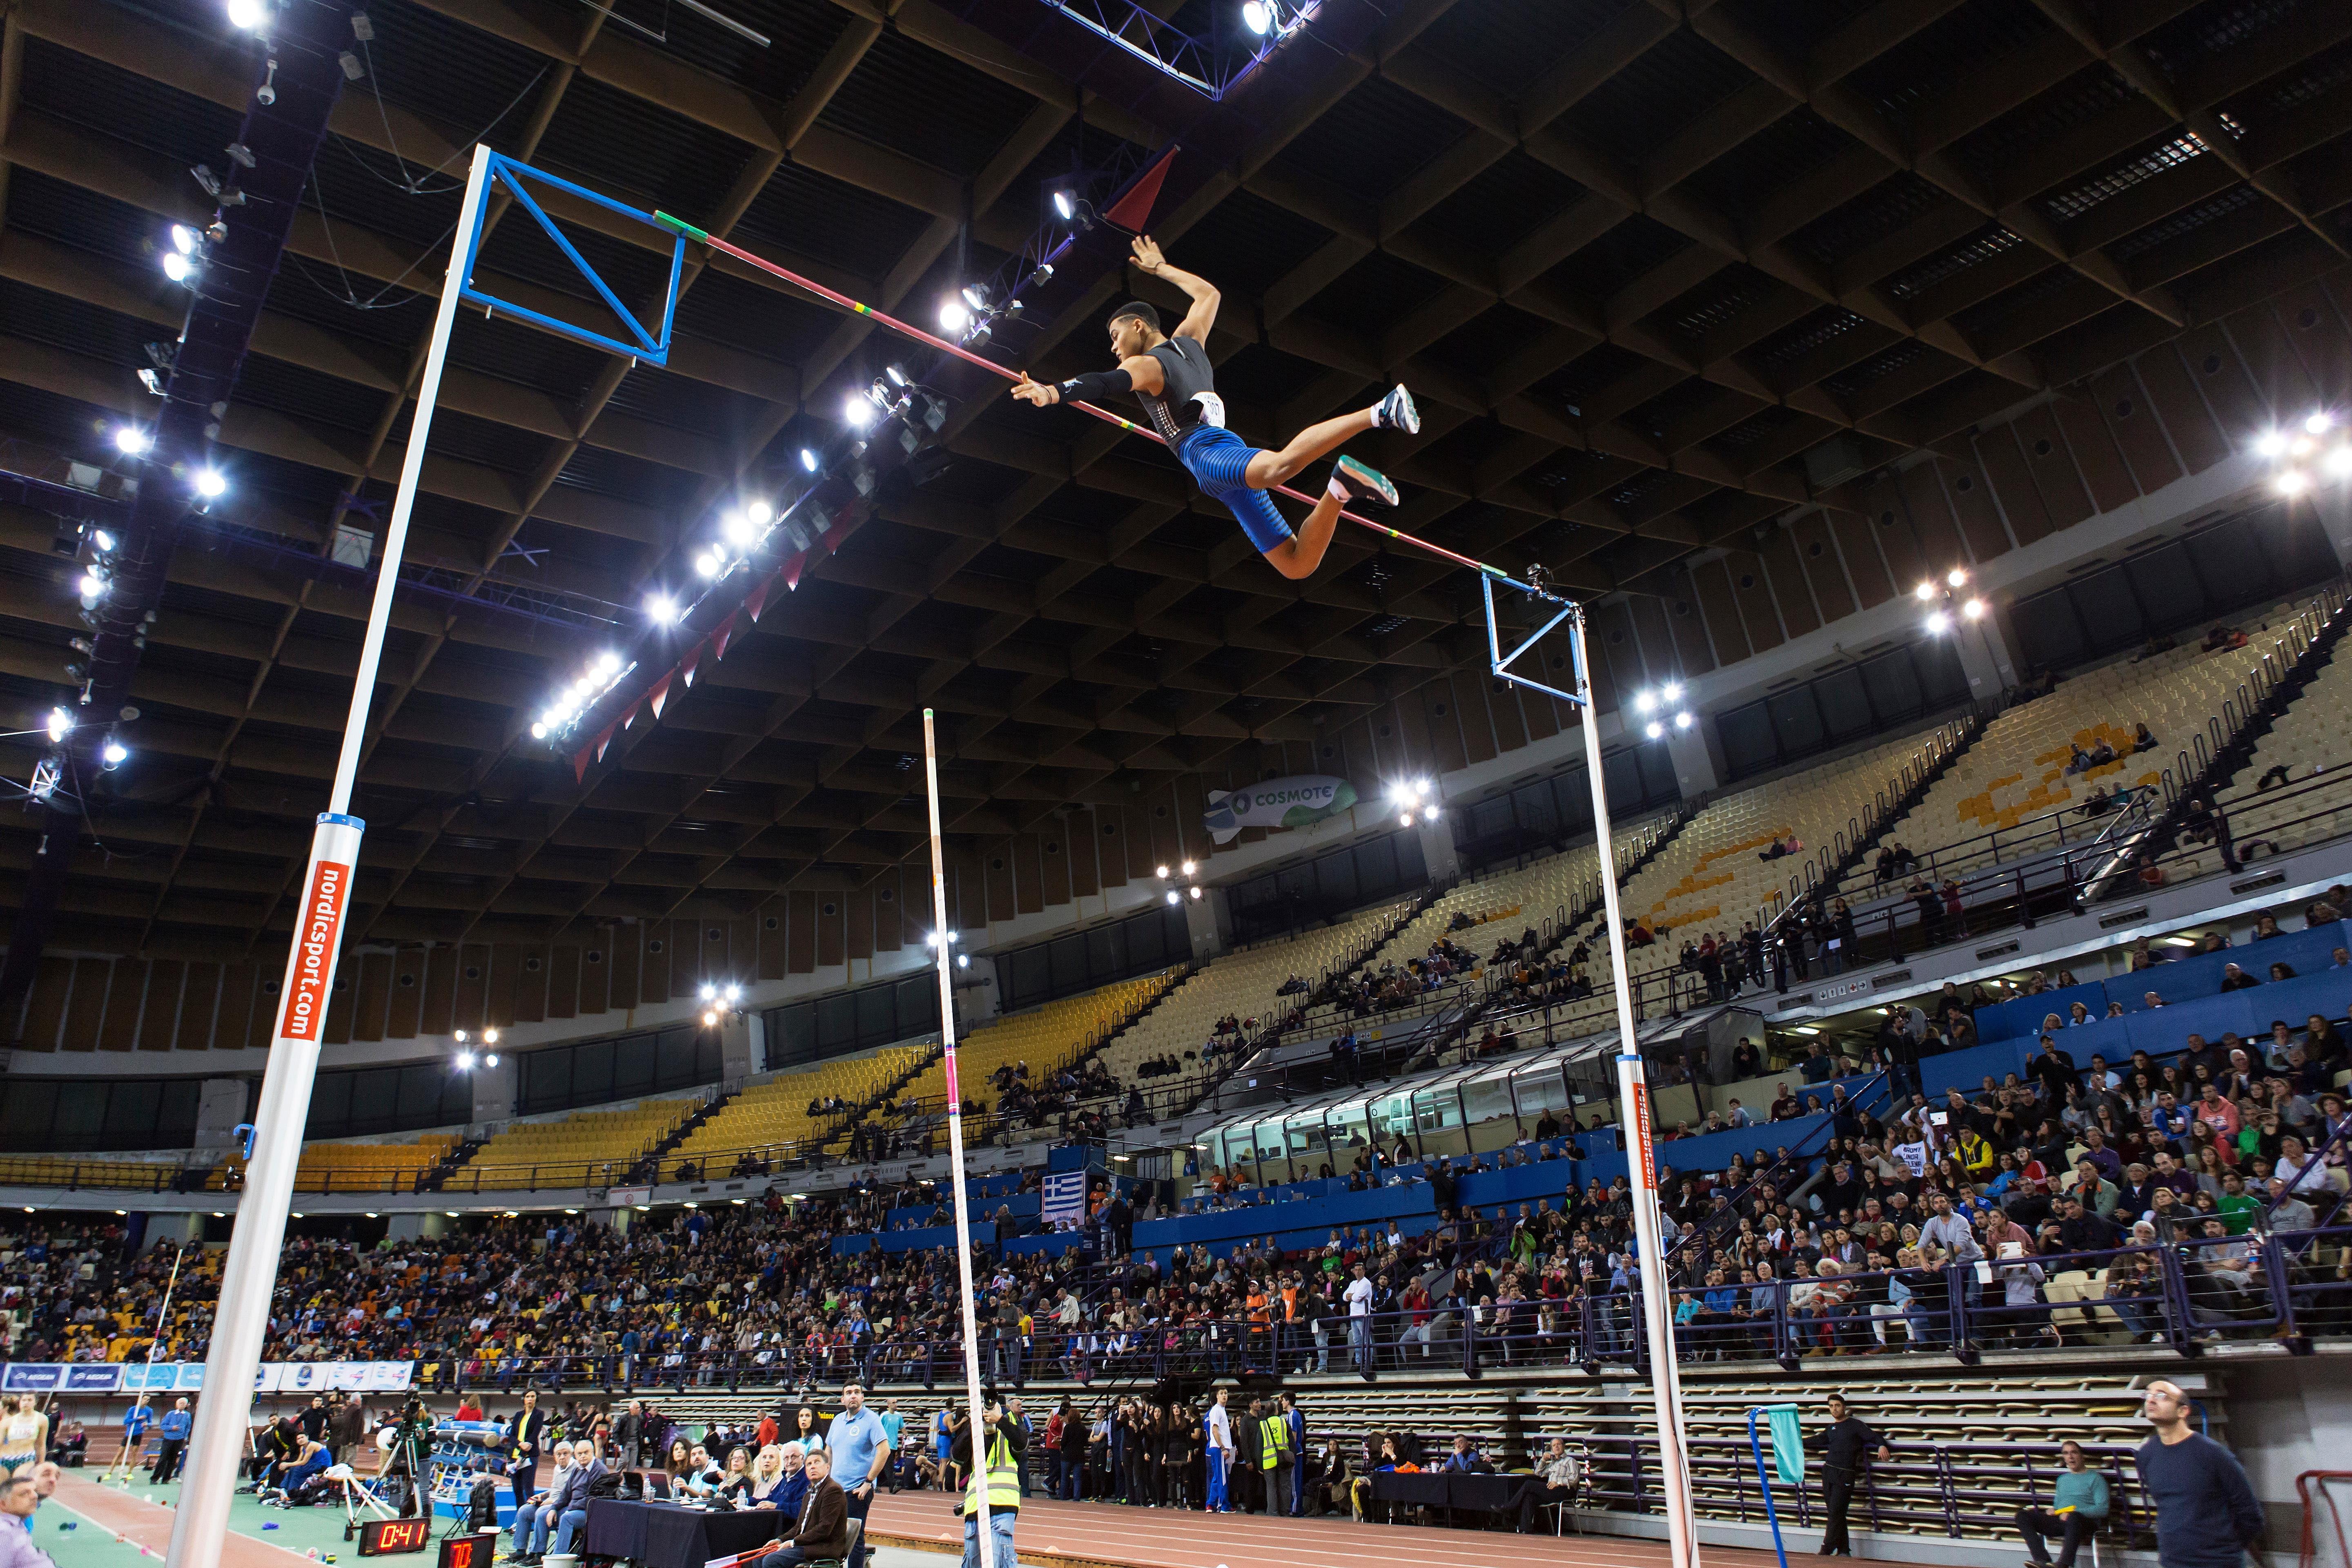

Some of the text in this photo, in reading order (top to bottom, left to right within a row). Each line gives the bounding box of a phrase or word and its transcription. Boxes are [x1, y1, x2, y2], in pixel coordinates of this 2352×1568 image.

[1255, 786, 1332, 807] COSMOTE
[290, 869, 340, 1034] nordicsport.com
[1638, 1088, 1655, 1187] nordicsport.com
[380, 1523, 425, 1548] 0:41
